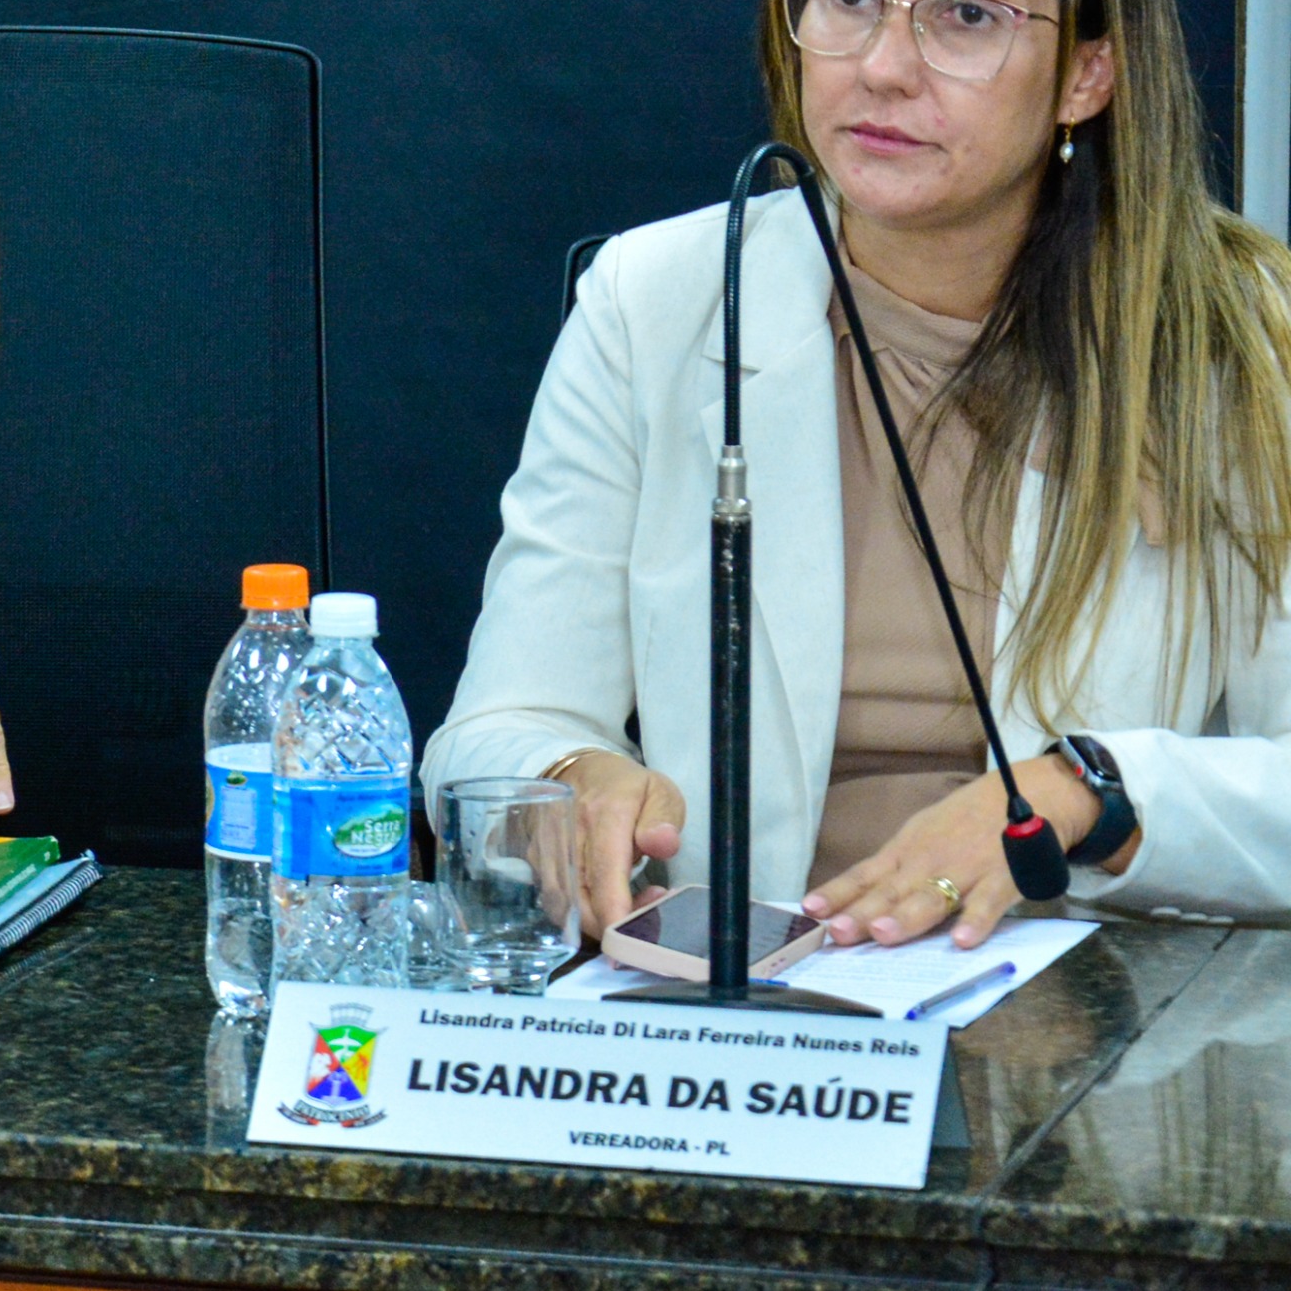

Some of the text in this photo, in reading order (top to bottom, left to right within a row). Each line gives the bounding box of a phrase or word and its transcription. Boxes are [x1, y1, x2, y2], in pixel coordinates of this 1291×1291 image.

[419, 1009, 920, 1057] Lisandra Patrícia Di Lara Ferreira Nunes Reis
[407, 1058, 913, 1124] LISANDRA DA SAÚDE
[569, 1131, 689, 1153] VEREADORA
[705, 1140, 730, 1156] PL
